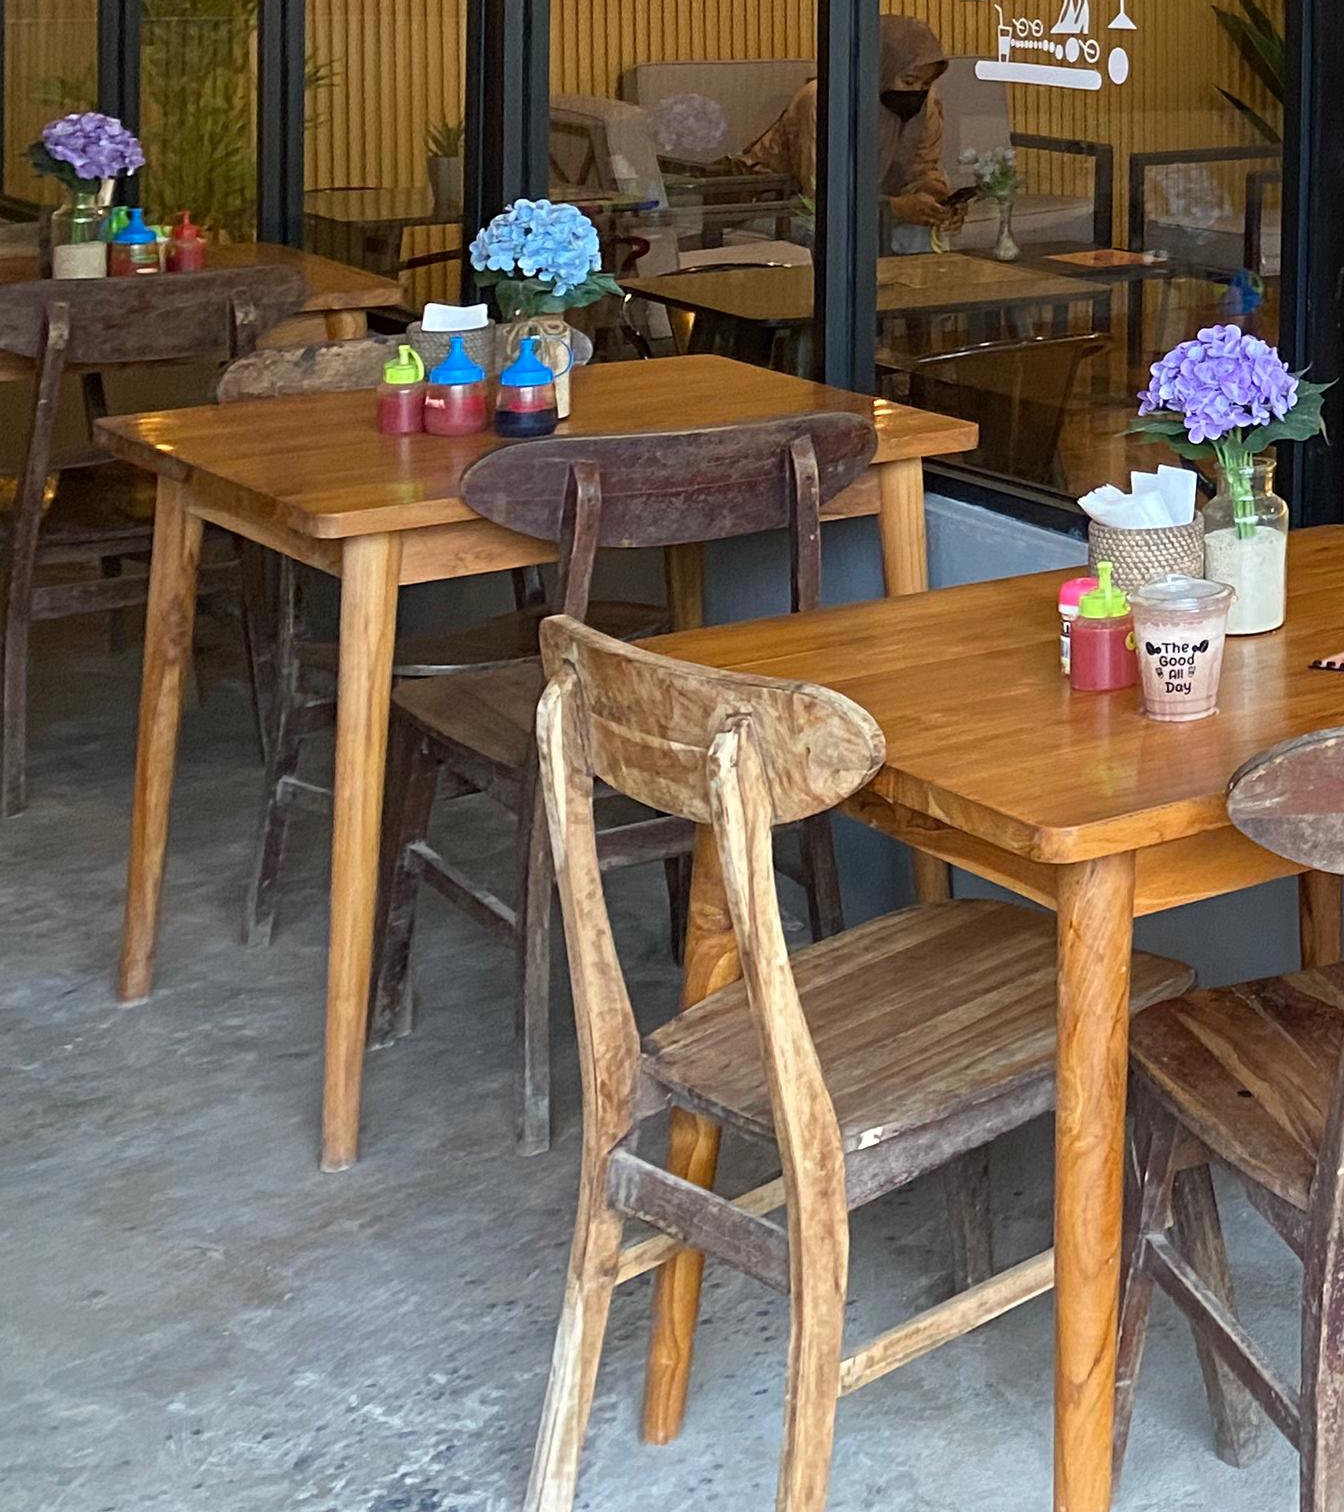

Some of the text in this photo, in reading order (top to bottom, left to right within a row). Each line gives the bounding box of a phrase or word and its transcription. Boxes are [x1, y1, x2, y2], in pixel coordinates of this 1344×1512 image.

[1161, 642, 1189, 654] The
[1159, 652, 1195, 667] Good
[1168, 667, 1184, 680] All
[1165, 681, 1192, 695] Day
